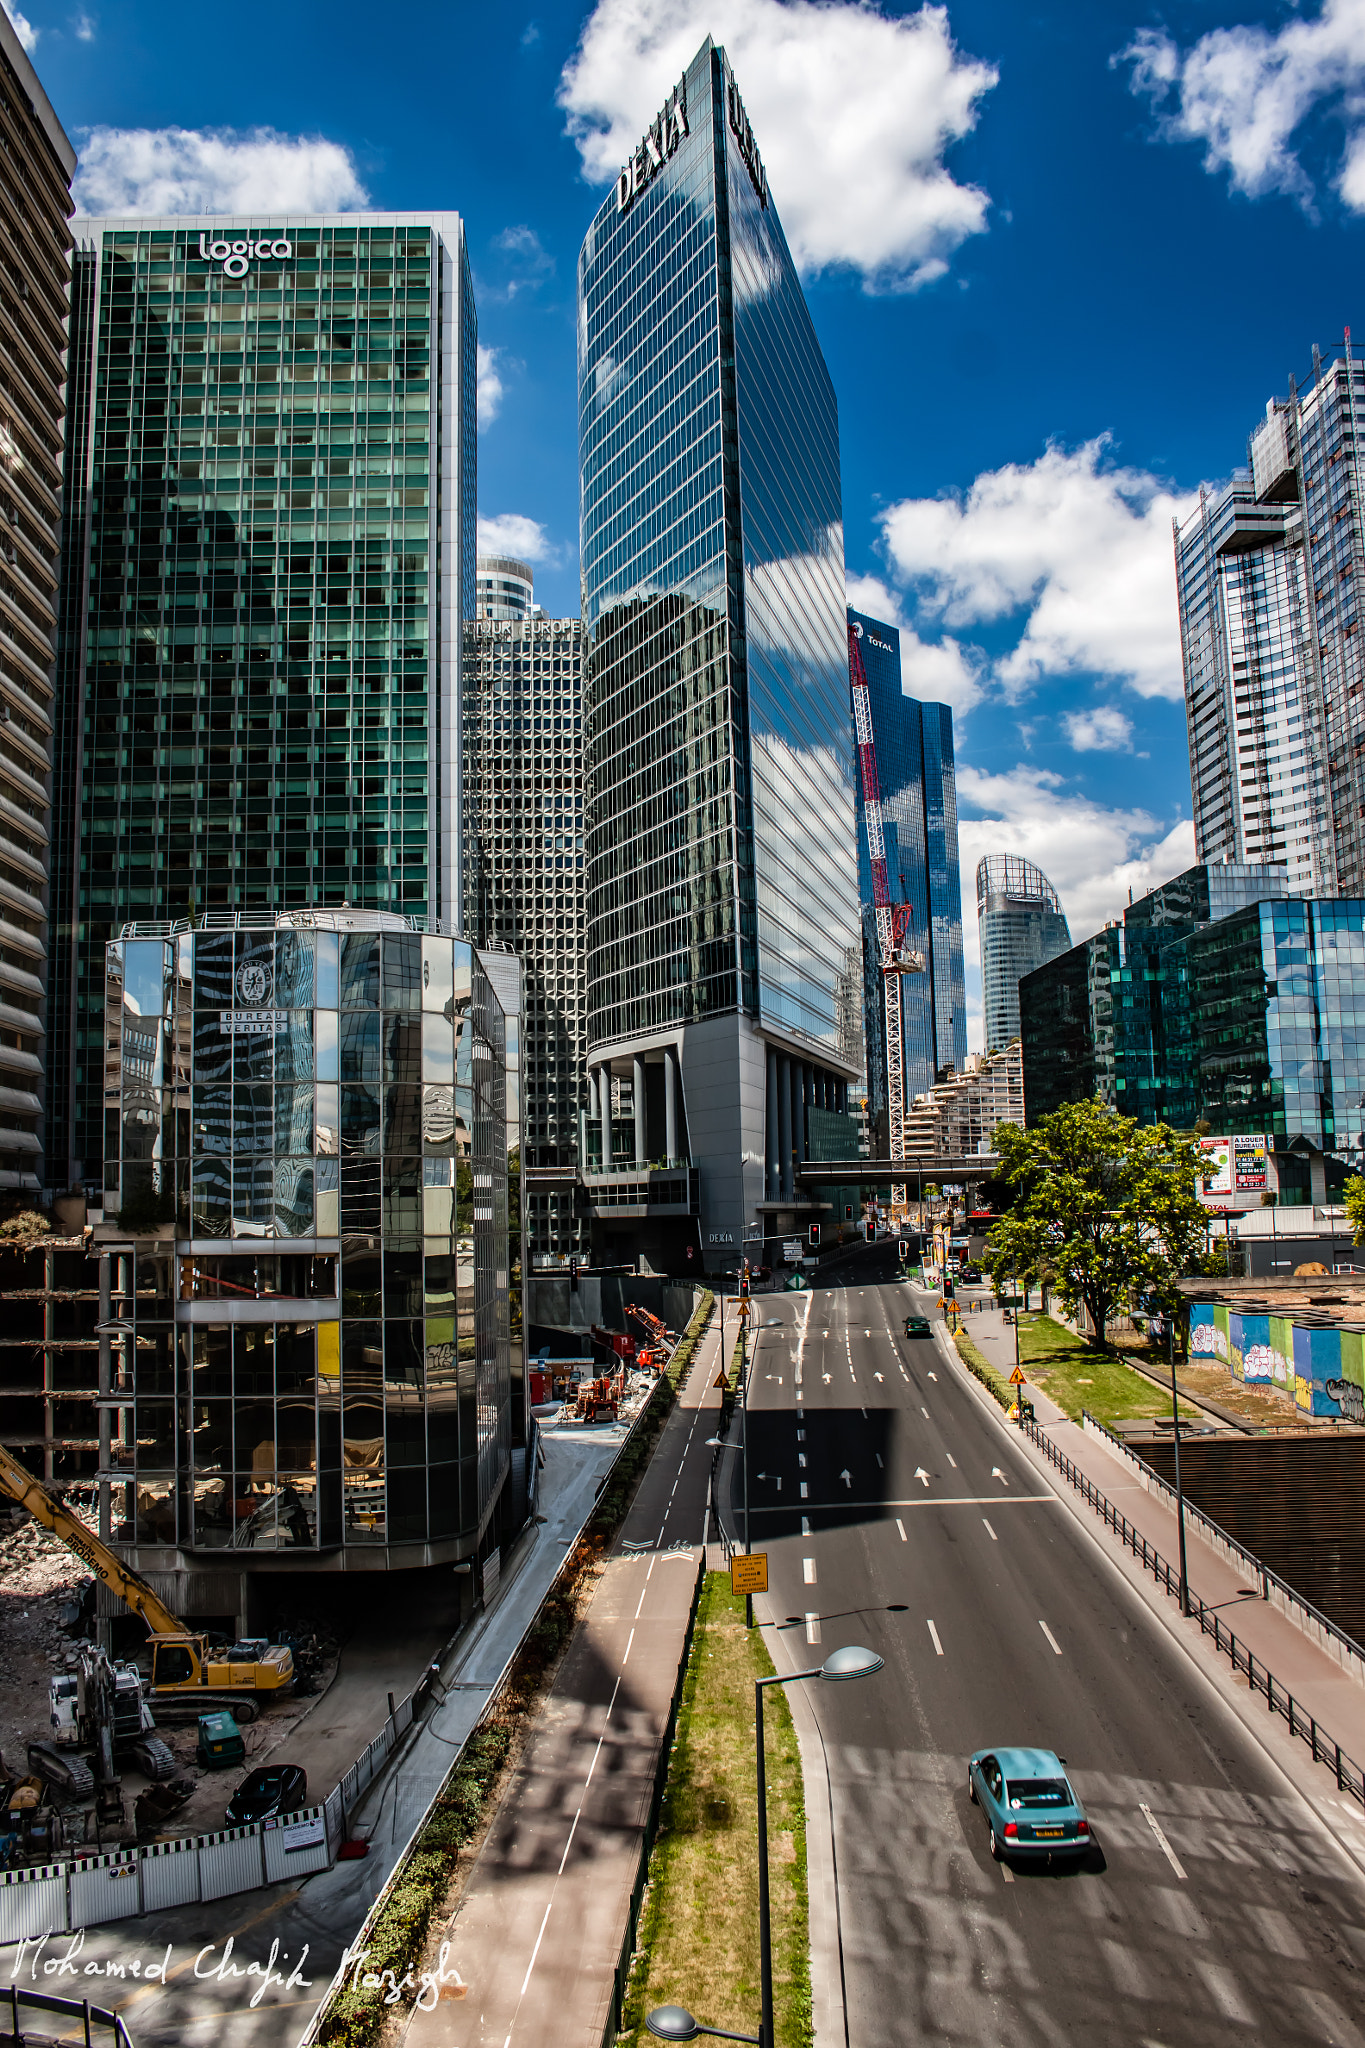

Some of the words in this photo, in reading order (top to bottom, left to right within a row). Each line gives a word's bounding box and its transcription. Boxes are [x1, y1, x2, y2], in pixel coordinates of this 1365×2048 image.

[617, 101, 689, 214] DEXIA
[200, 233, 292, 279] logica
[867, 634, 894, 653] TOTAL
[225, 1012, 282, 1021] BUREAU
[225, 1023, 282, 1032] VERITAS
[709, 1231, 734, 1243] DEXIA
[64, 1536, 109, 1580] PRODEMO
